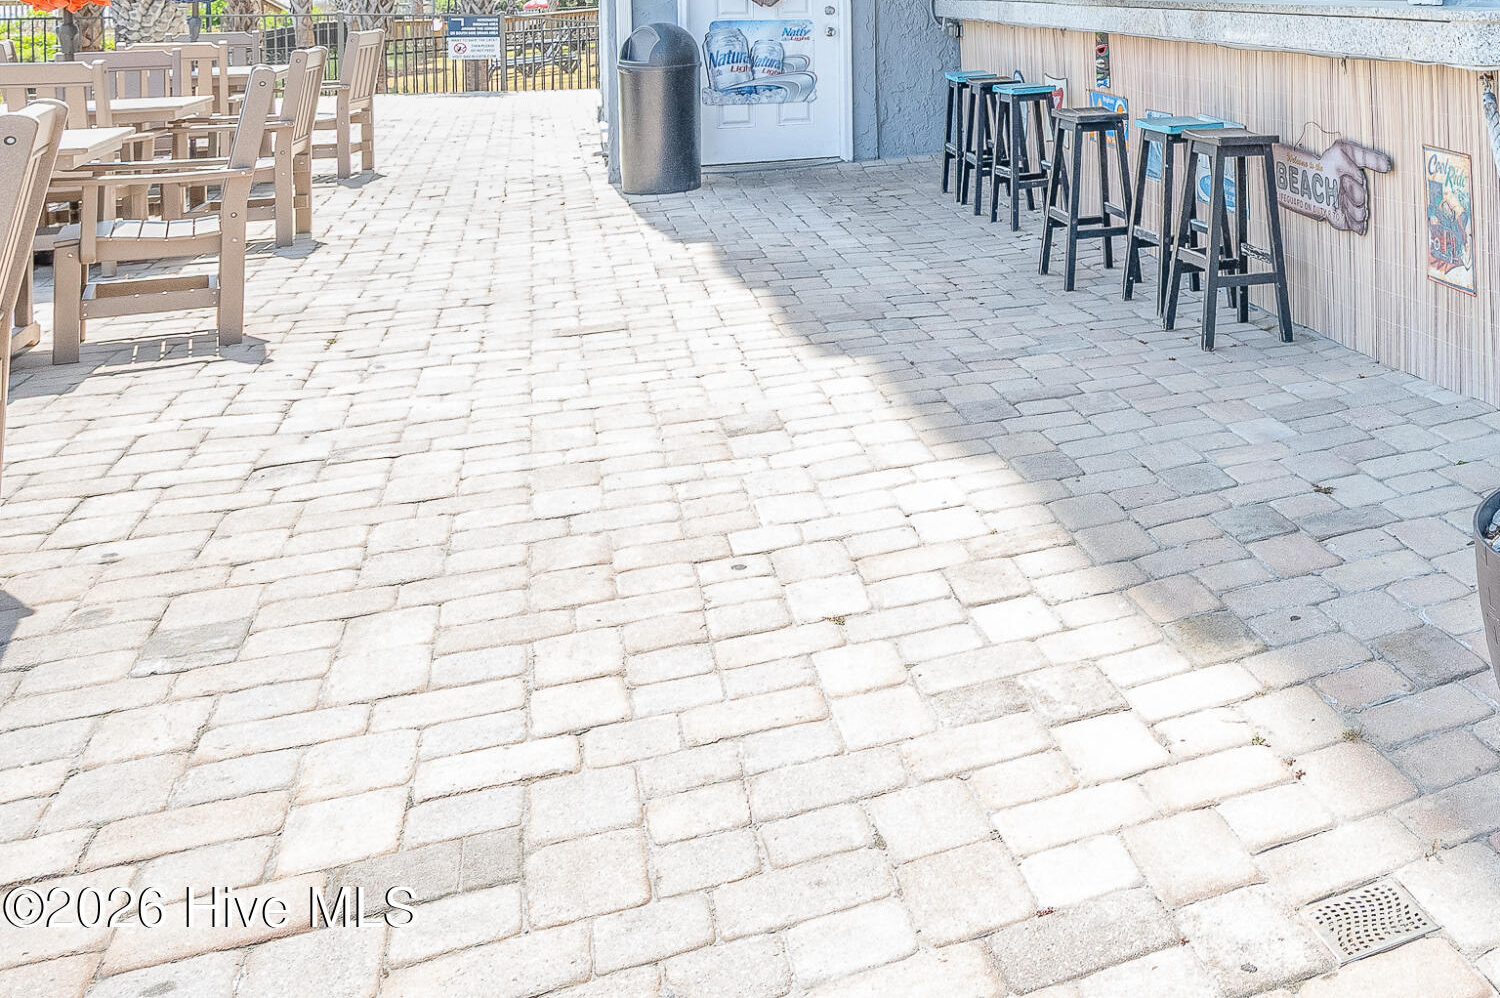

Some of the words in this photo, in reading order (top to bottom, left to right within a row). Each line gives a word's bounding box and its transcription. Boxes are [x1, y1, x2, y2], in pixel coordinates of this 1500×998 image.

[782, 26, 811, 37] Natty
[709, 50, 752, 69] Natura
[1286, 151, 1309, 167] Welcome
[1316, 162, 1324, 172] the
[1428, 154, 1449, 176] Cool
[1276, 161, 1340, 209] BEACH
[1444, 165, 1467, 189] Ride
